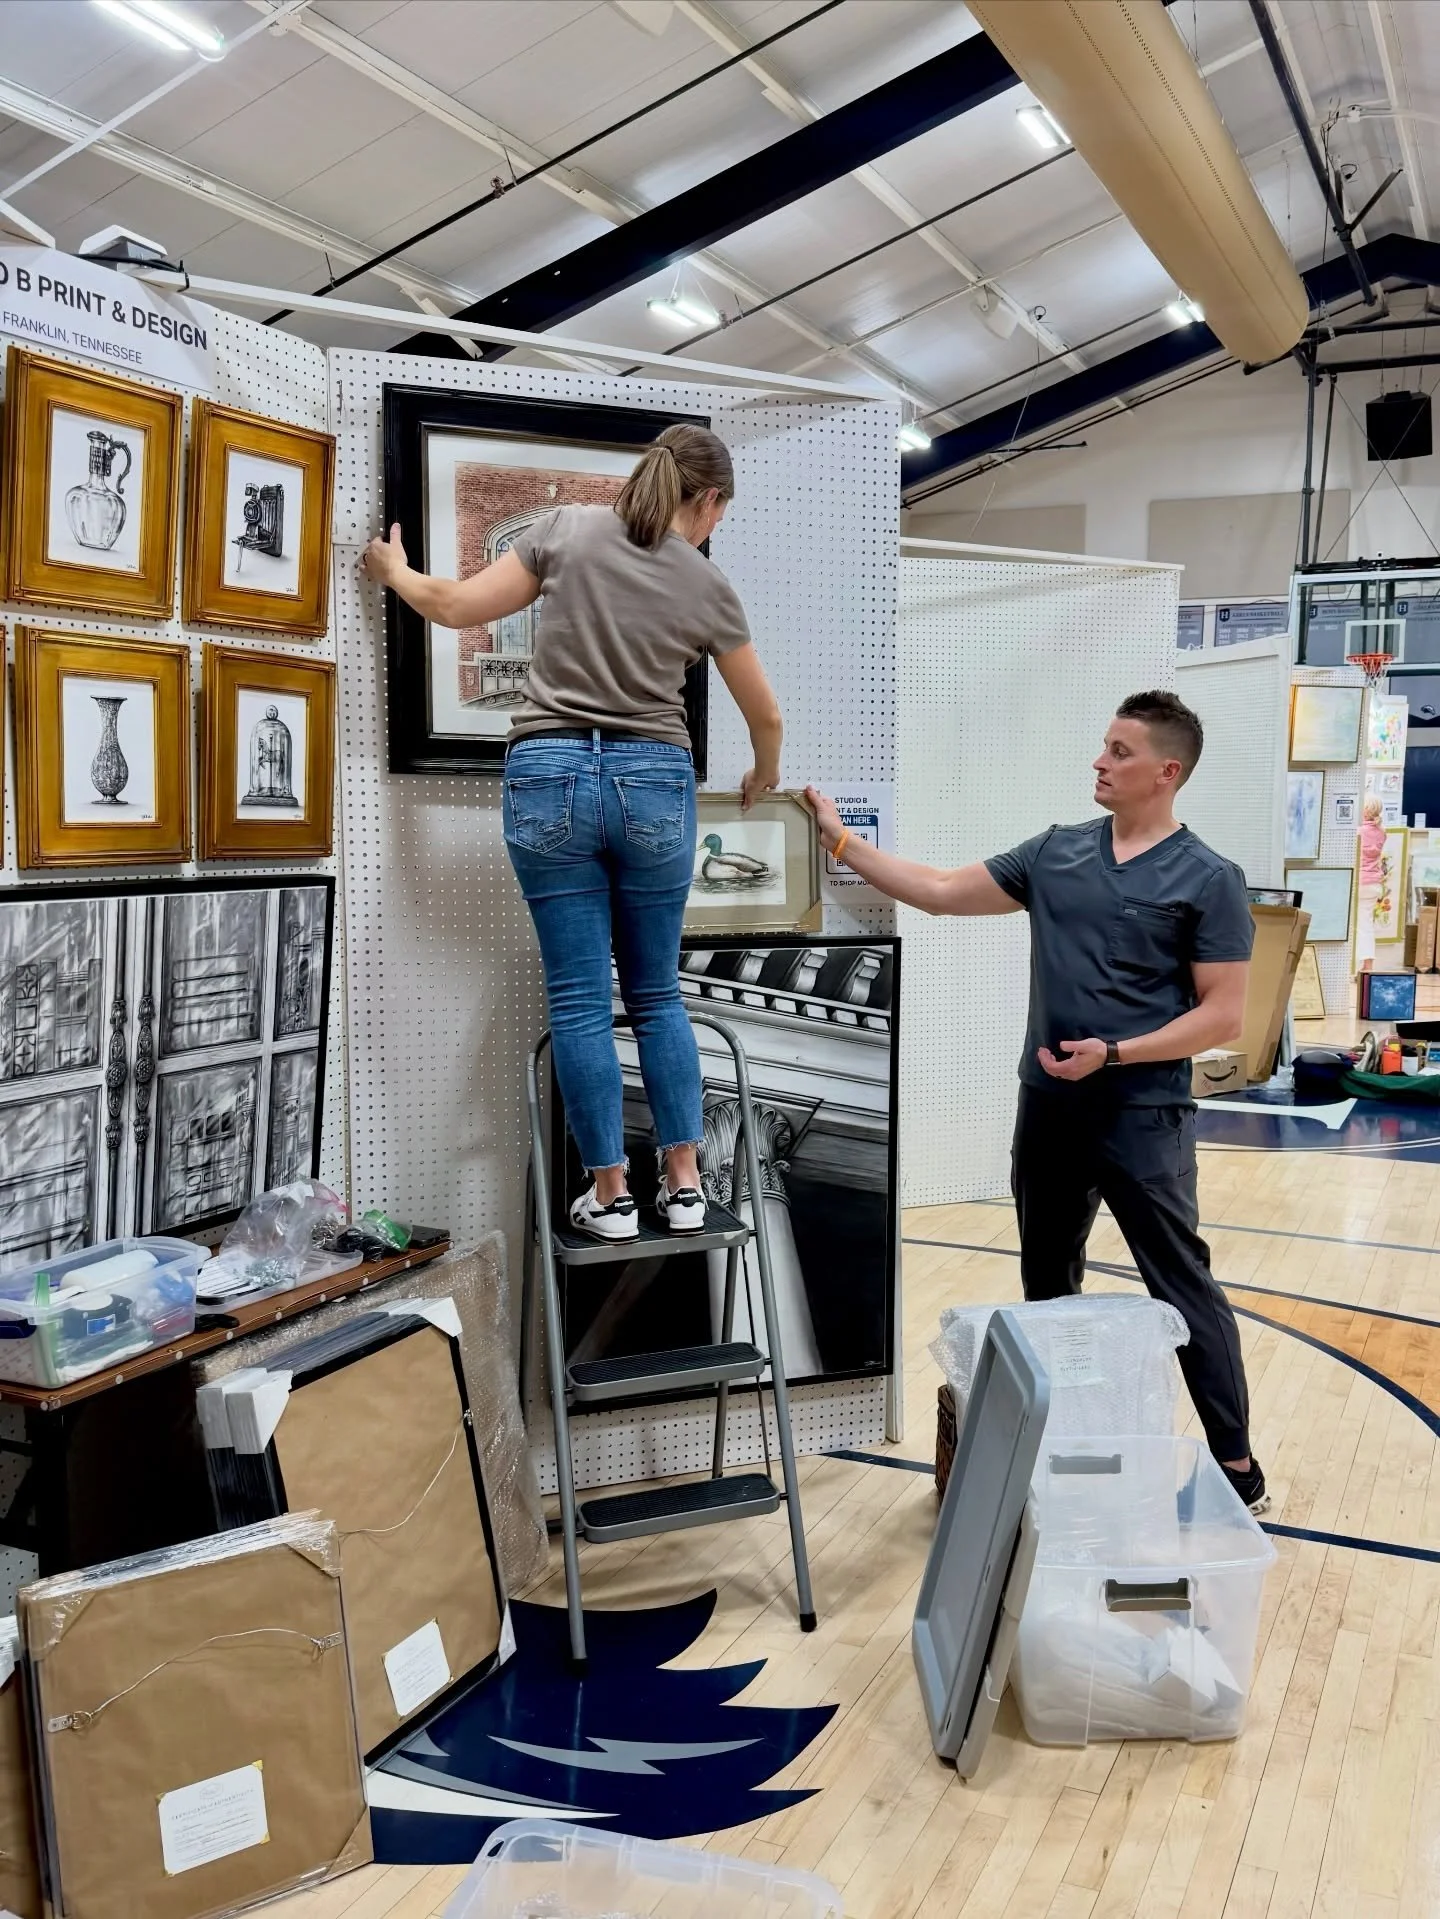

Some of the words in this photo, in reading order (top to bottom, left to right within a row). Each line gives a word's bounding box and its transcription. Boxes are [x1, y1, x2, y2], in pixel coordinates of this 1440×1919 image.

[3, 311, 70, 344] FRANKLIN,
[72, 332, 143, 364] TENNESSEE
[17, 267, 31, 292] B
[39, 275, 106, 316] PRINT
[112, 300, 126, 323] &
[133, 306, 207, 350] DESIGN
